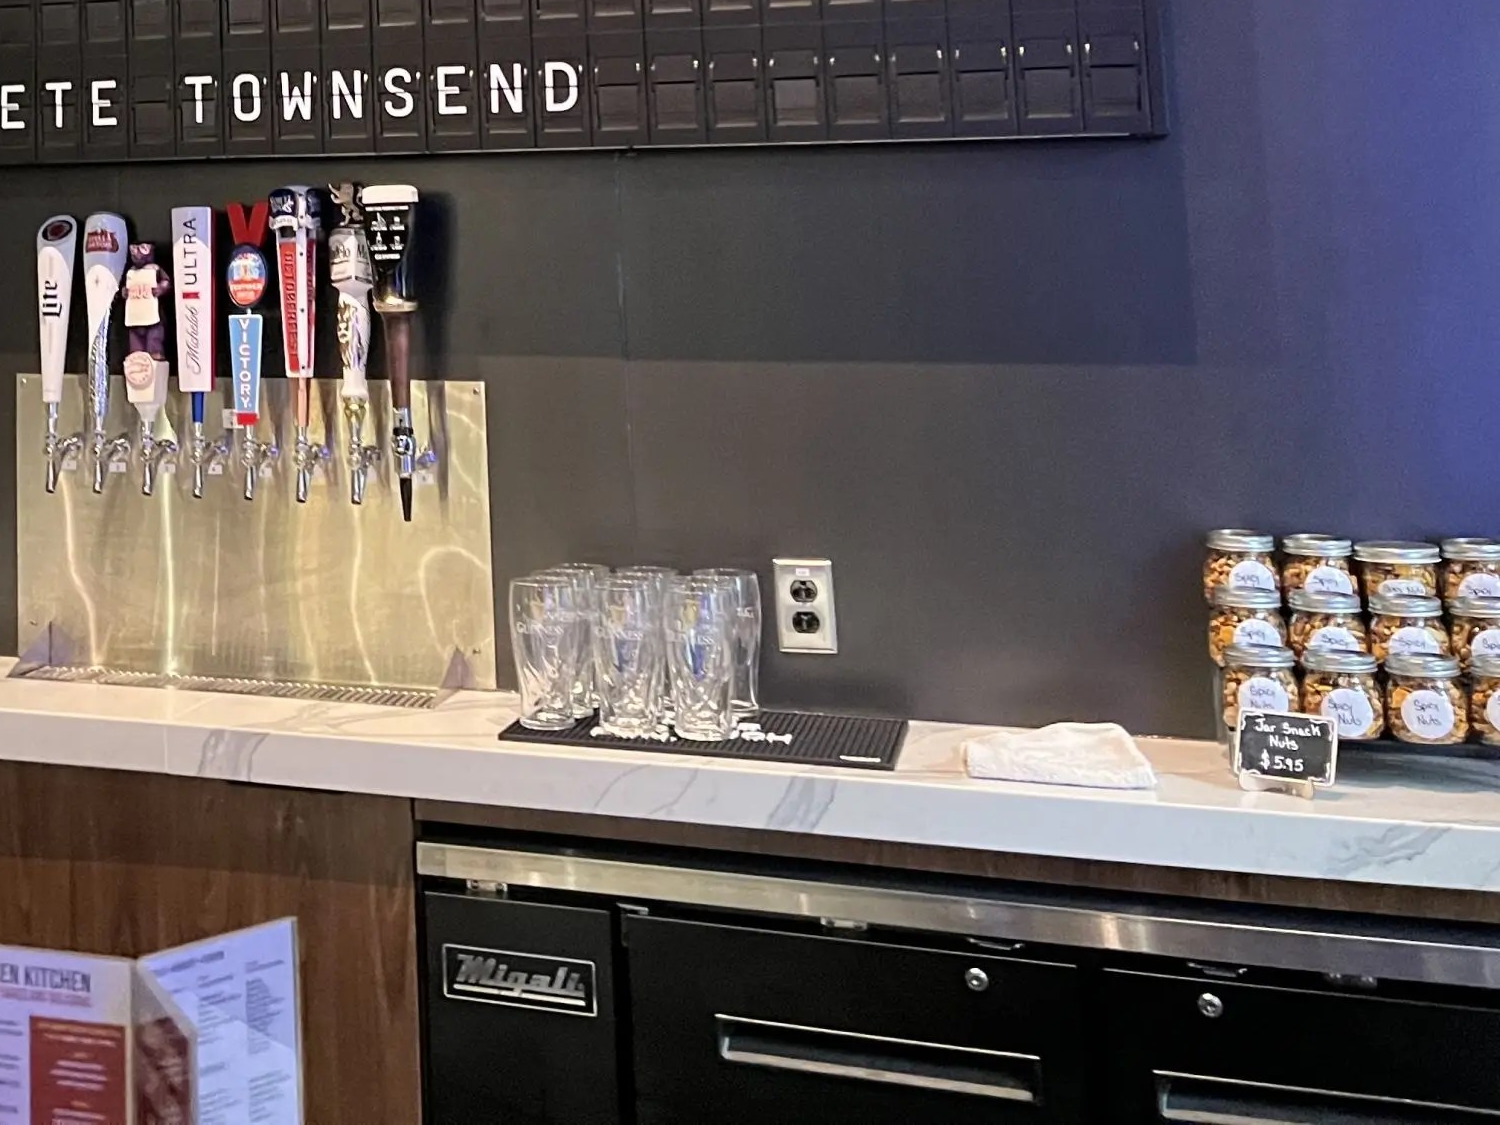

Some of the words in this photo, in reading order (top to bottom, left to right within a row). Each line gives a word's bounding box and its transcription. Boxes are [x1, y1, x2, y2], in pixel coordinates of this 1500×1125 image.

[184, 61, 579, 124] TOWNSEND
[182, 217, 197, 286] ULTRA
[42, 280, 63, 317] Lite
[185, 306, 201, 374] Michelob
[238, 318, 250, 408] VICTORY
[1255, 718, 1277, 733] Jar
[1282, 722, 1321, 736] Snack
[1269, 735, 1299, 751] Nuts
[25, 966, 92, 993] KITCHEN
